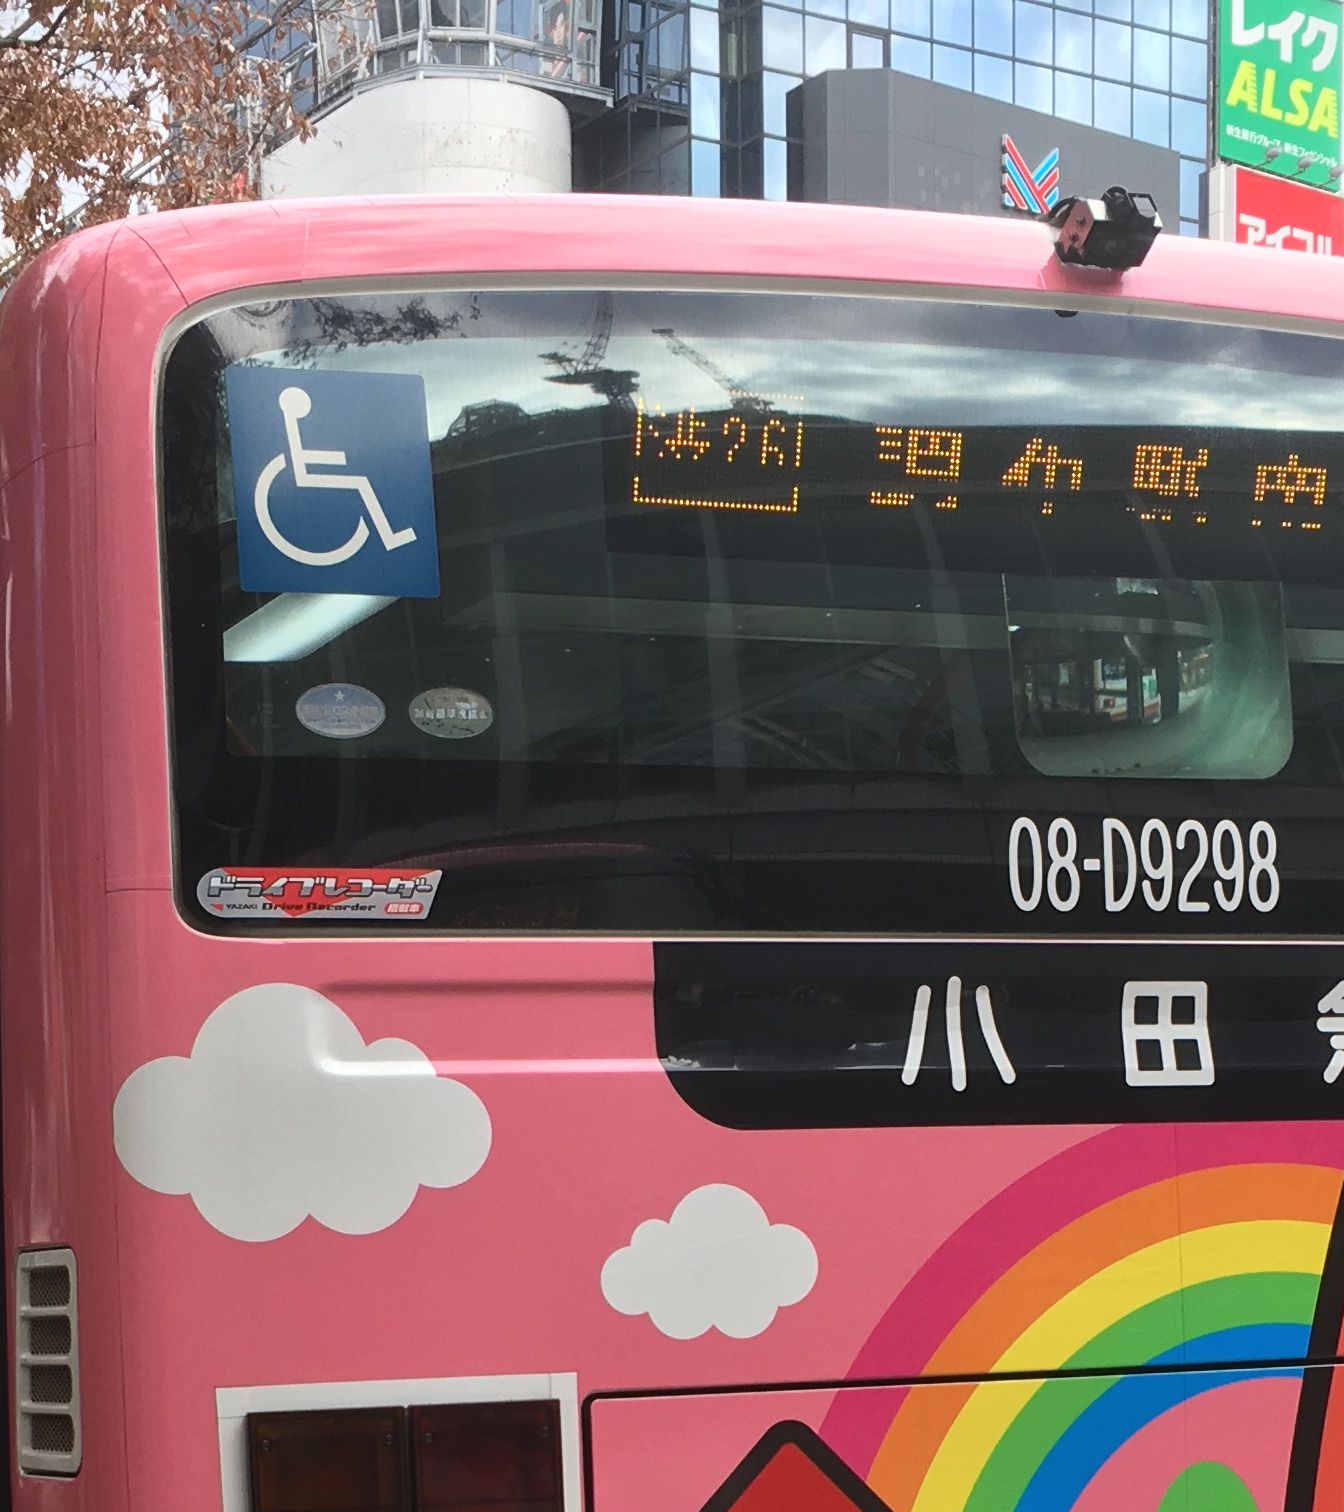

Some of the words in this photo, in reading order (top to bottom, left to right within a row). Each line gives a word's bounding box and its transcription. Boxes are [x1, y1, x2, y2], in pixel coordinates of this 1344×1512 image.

[1231, 0, 1338, 72] レイク
[1226, 59, 1339, 139] ALSA
[207, 874, 433, 899] ドライブレコーダー
[1008, 816, 1281, 914] 08-D9298
[225, 903, 258, 911] YAZAKI
[261, 902, 304, 912] Drive
[306, 902, 377, 912] Recorder
